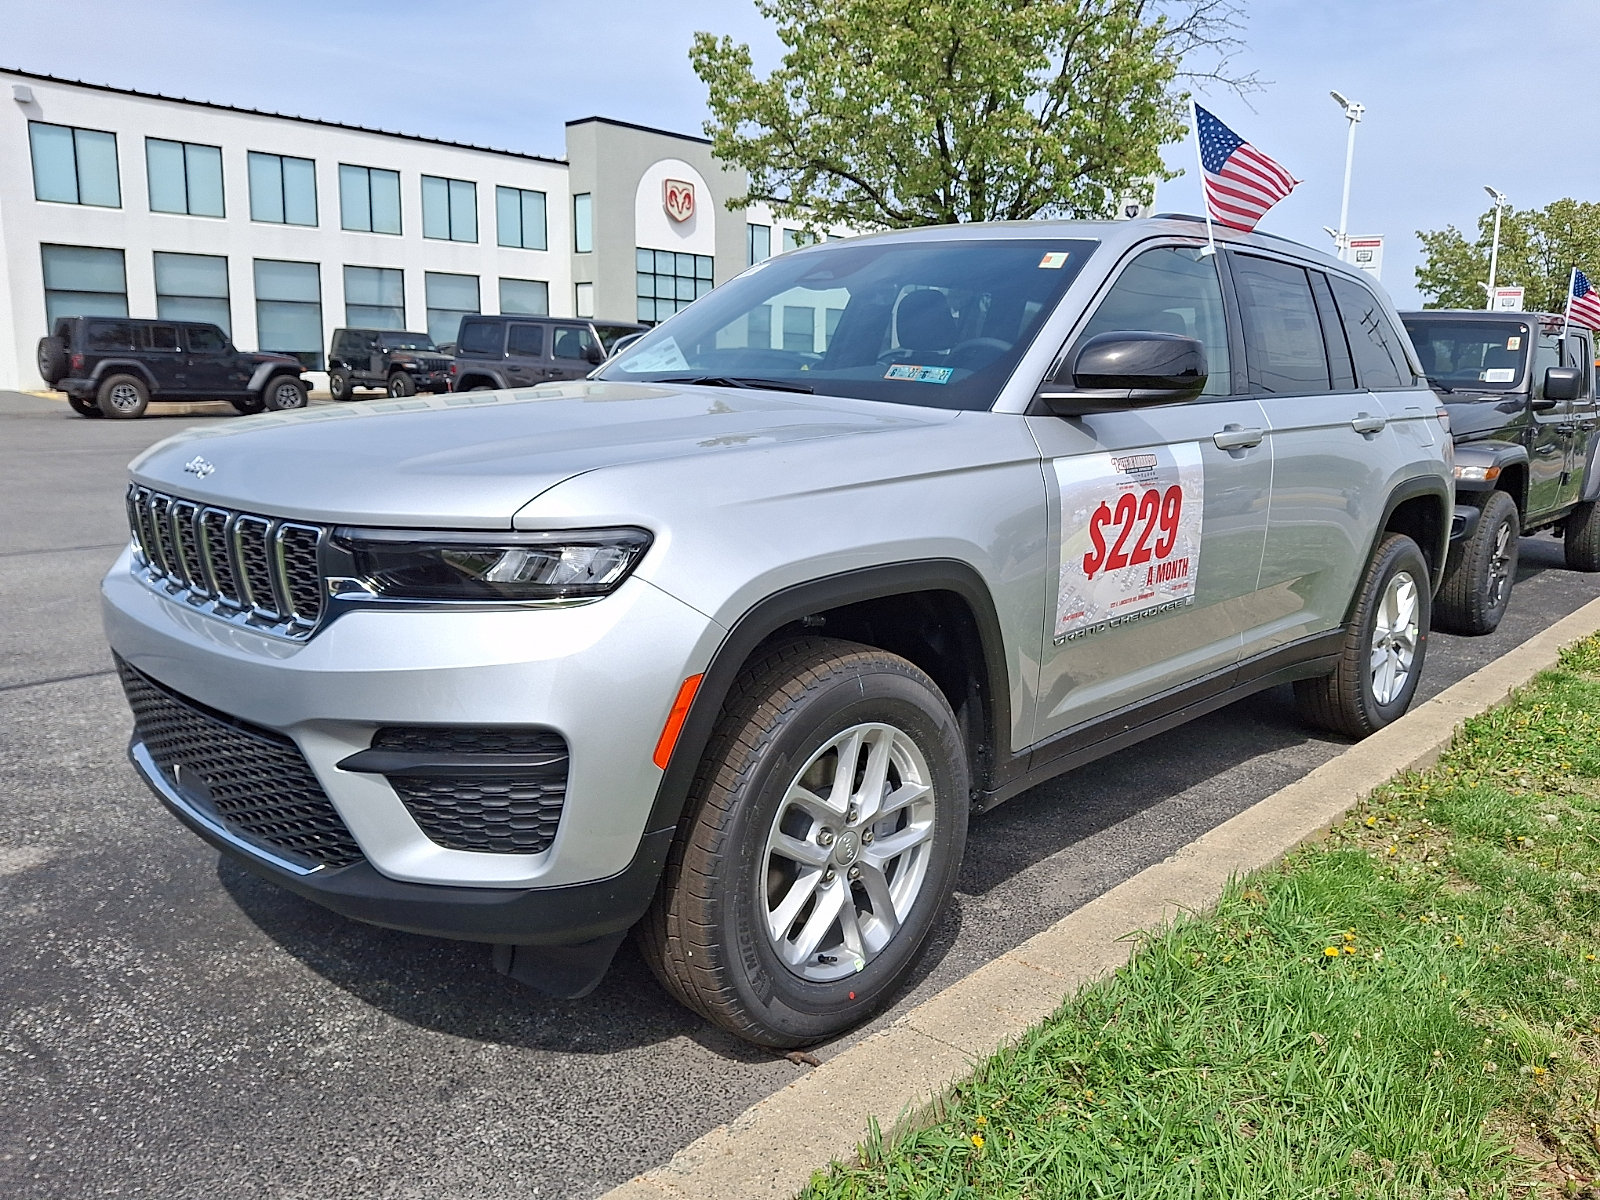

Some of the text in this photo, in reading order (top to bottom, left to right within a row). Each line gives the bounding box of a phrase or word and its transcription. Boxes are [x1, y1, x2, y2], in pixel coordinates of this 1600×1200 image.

[184, 455, 215, 479] Jeep
[1083, 485, 1183, 580] $229
[1146, 557, 1189, 586] A MONTH
[1053, 623, 1106, 646] GRAND
[1109, 601, 1183, 628] CHEROKEE
